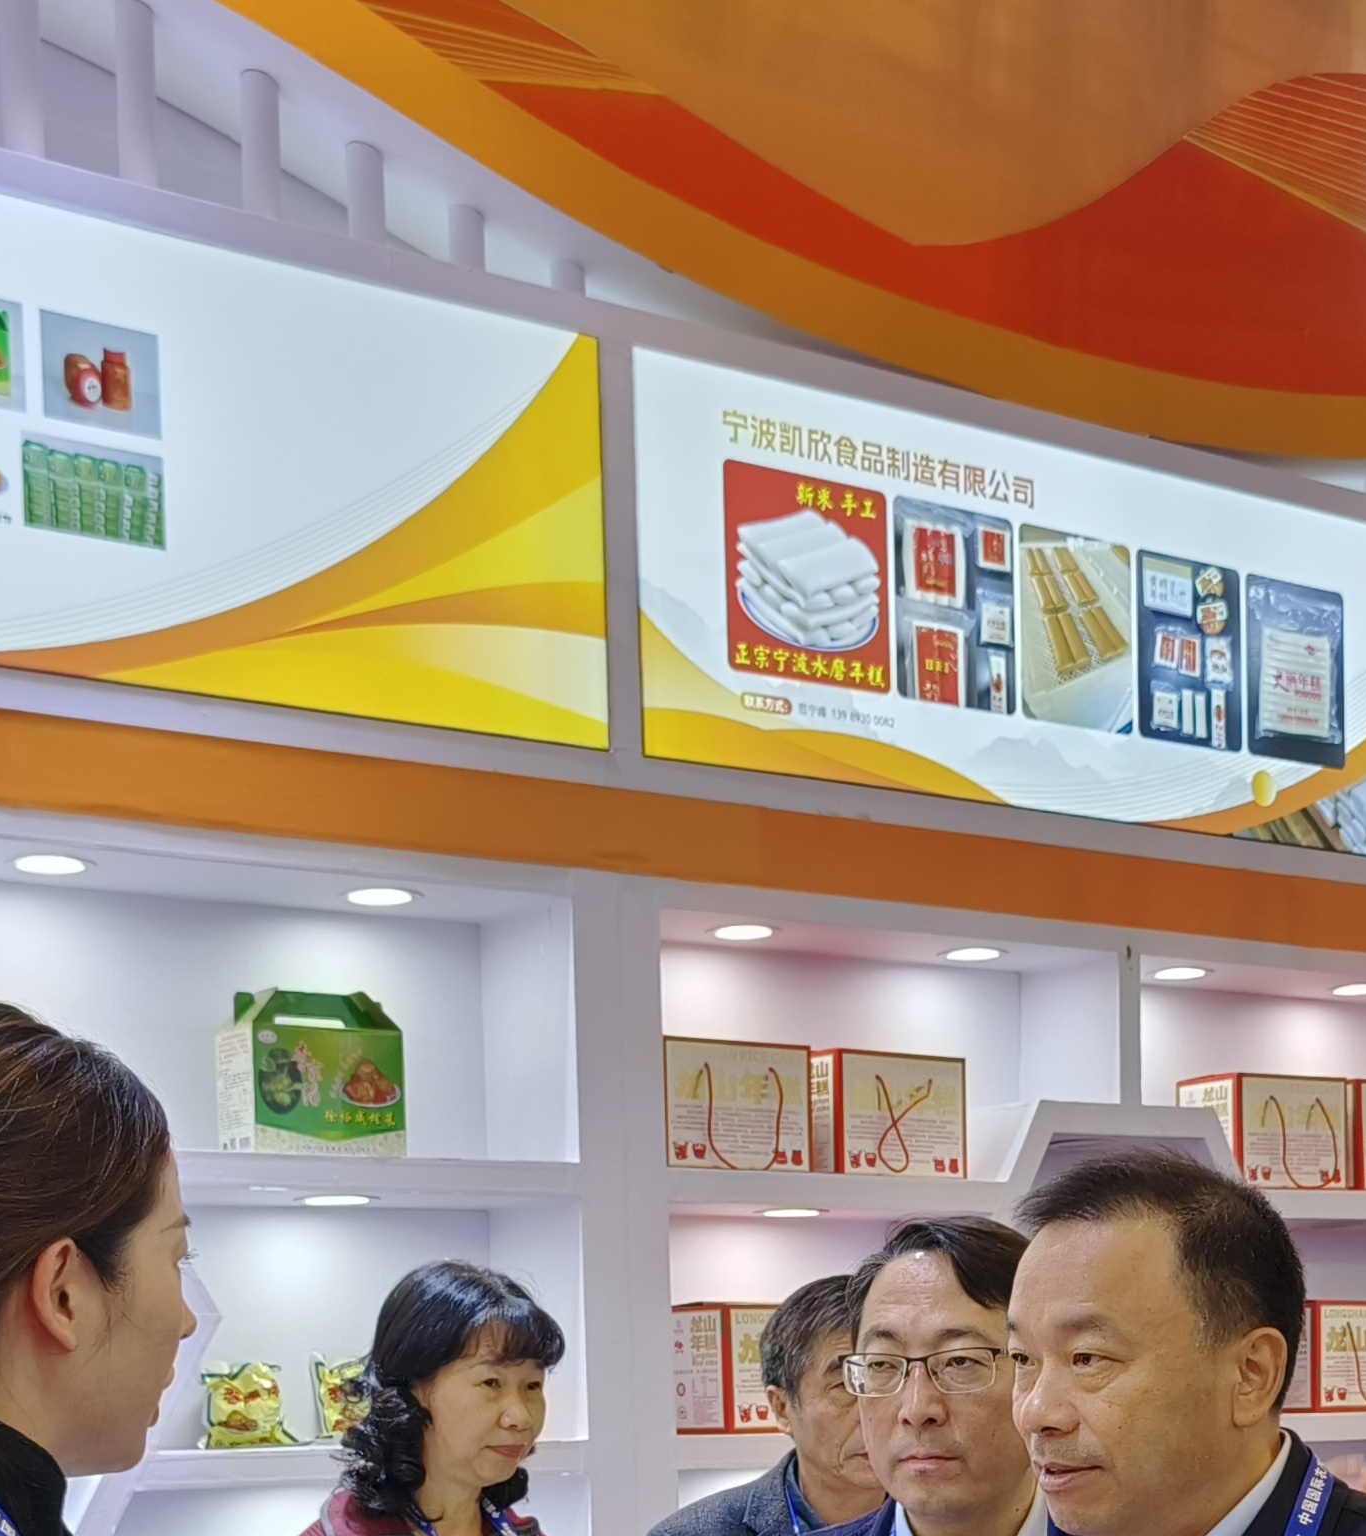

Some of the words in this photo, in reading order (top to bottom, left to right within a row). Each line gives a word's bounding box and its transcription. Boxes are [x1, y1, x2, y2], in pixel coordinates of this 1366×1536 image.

[722, 410, 1035, 509] 宁波凯欣食品制造有限公司
[735, 643, 885, 688] 正宗宁波水磨年糕
